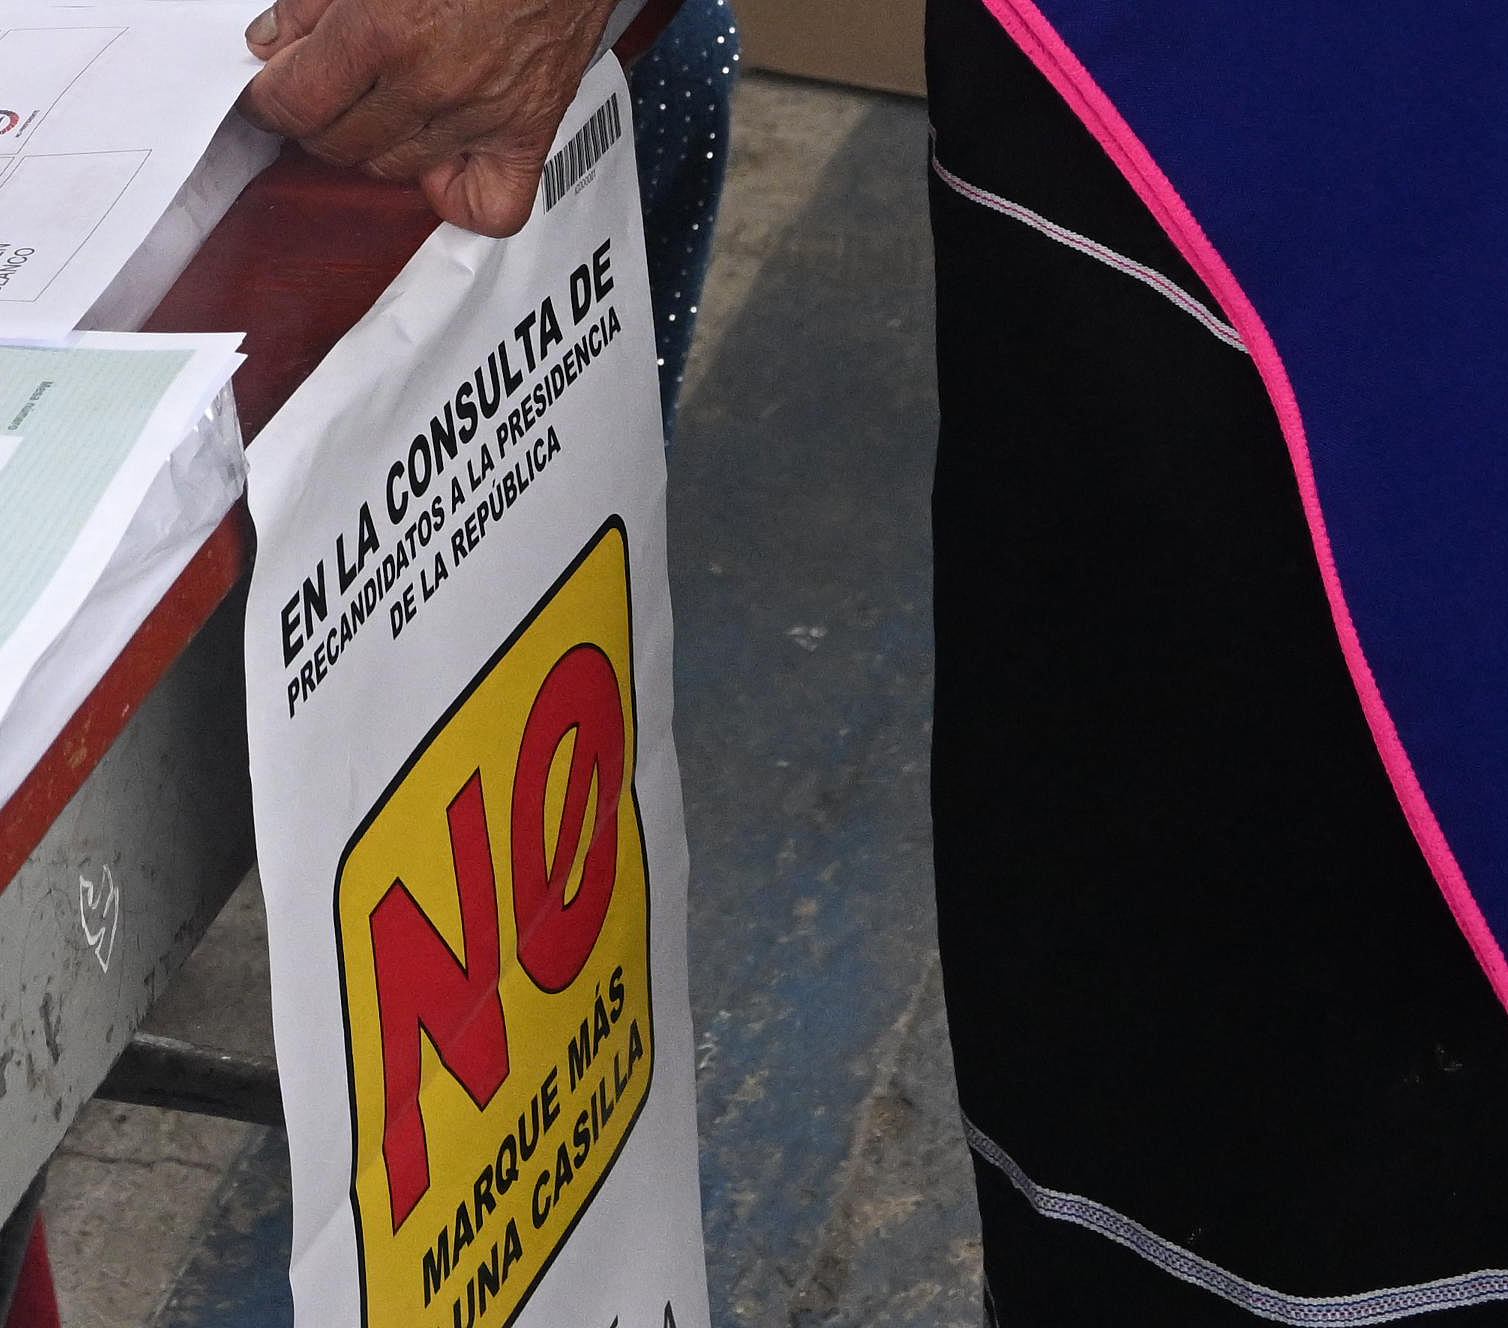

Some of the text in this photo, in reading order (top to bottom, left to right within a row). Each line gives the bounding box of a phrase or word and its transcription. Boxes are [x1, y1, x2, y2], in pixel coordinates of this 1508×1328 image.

[29, 381, 55, 401] Mesa
[279, 558, 329, 669] EN
[336, 500, 381, 595] LA
[385, 295, 565, 526] CONSULTA
[569, 238, 618, 328] DE
[286, 305, 623, 720] PRECANDIDATOS A LA PRESIDENCIA
[389, 424, 563, 641] DE LA REPÚBLICA
[369, 641, 626, 1236] NO
[421, 965, 625, 1309] MARQUE MÁS
[452, 1216, 526, 1328] UNA
[531, 1017, 645, 1231] CASILLA
